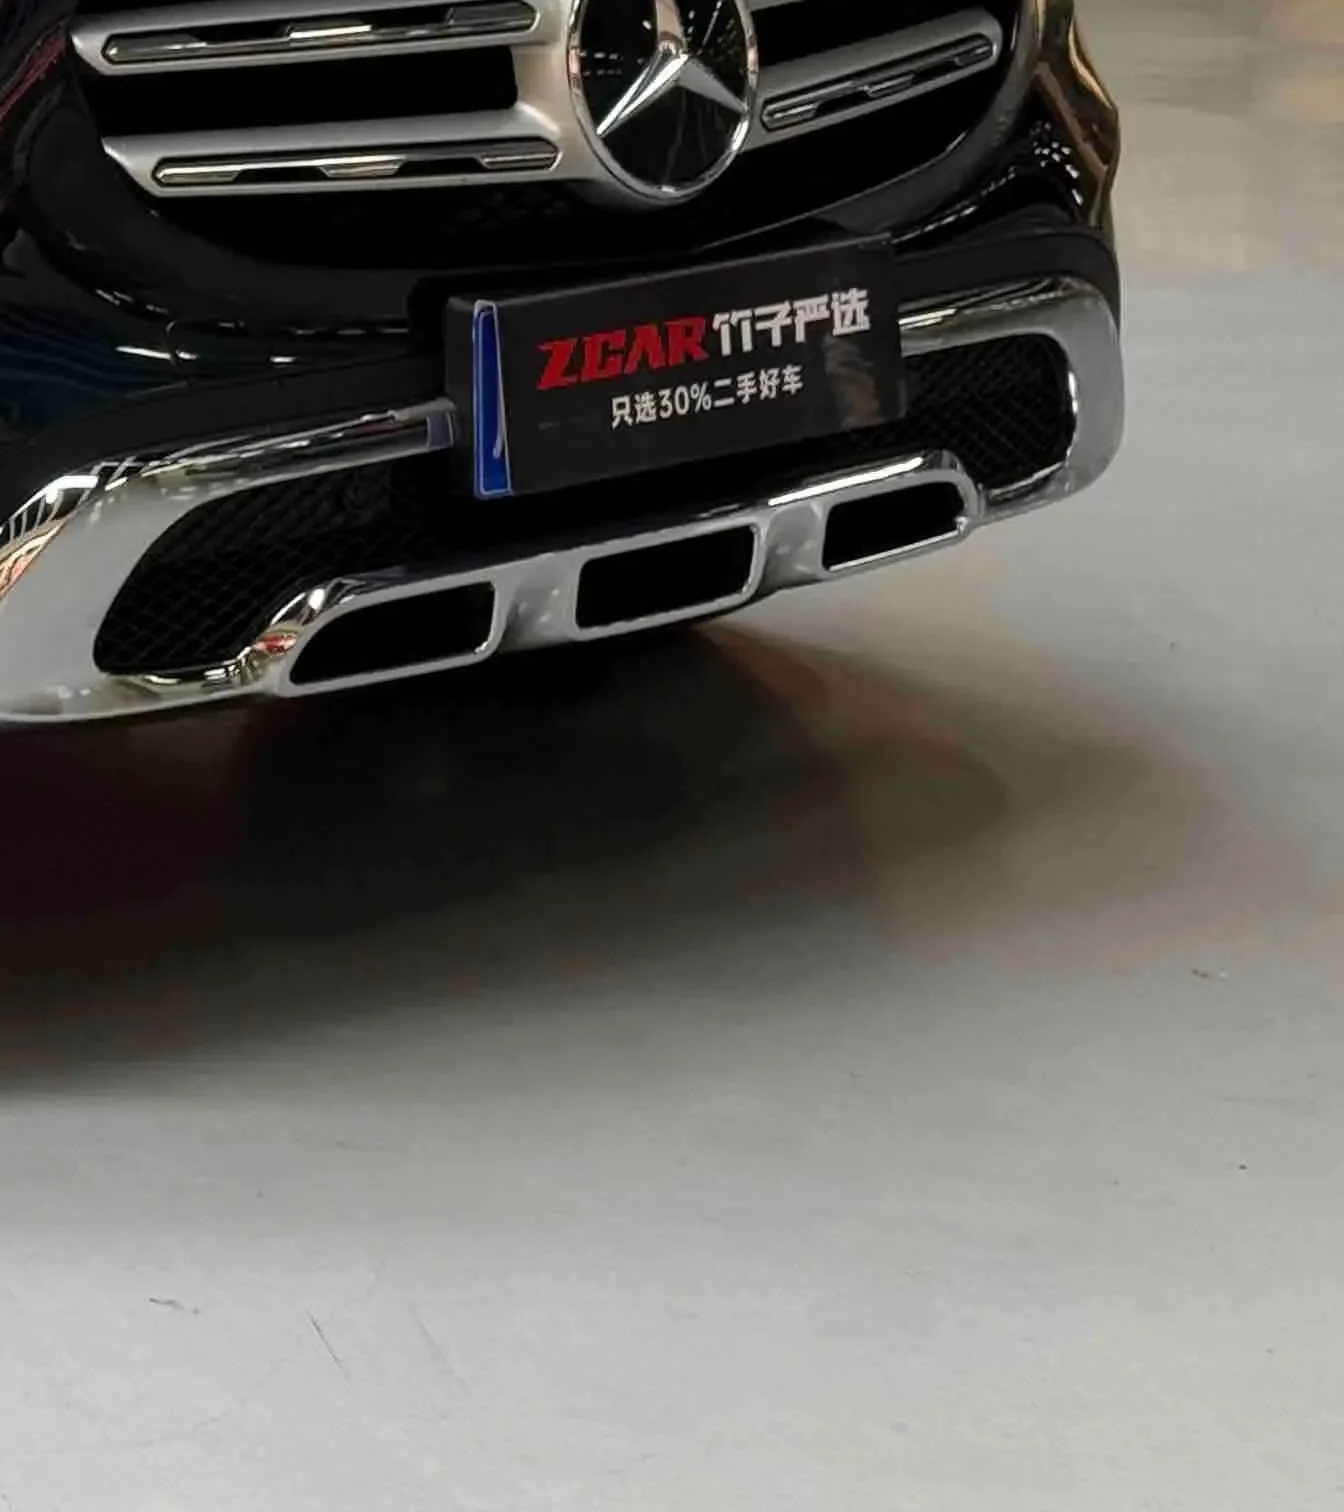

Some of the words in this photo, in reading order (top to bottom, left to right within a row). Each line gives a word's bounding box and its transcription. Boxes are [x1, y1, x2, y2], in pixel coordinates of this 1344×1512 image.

[538, 316, 708, 389] ZCAR
[712, 288, 871, 357] 竹子严选
[611, 364, 804, 429] 只选30%二手好车
